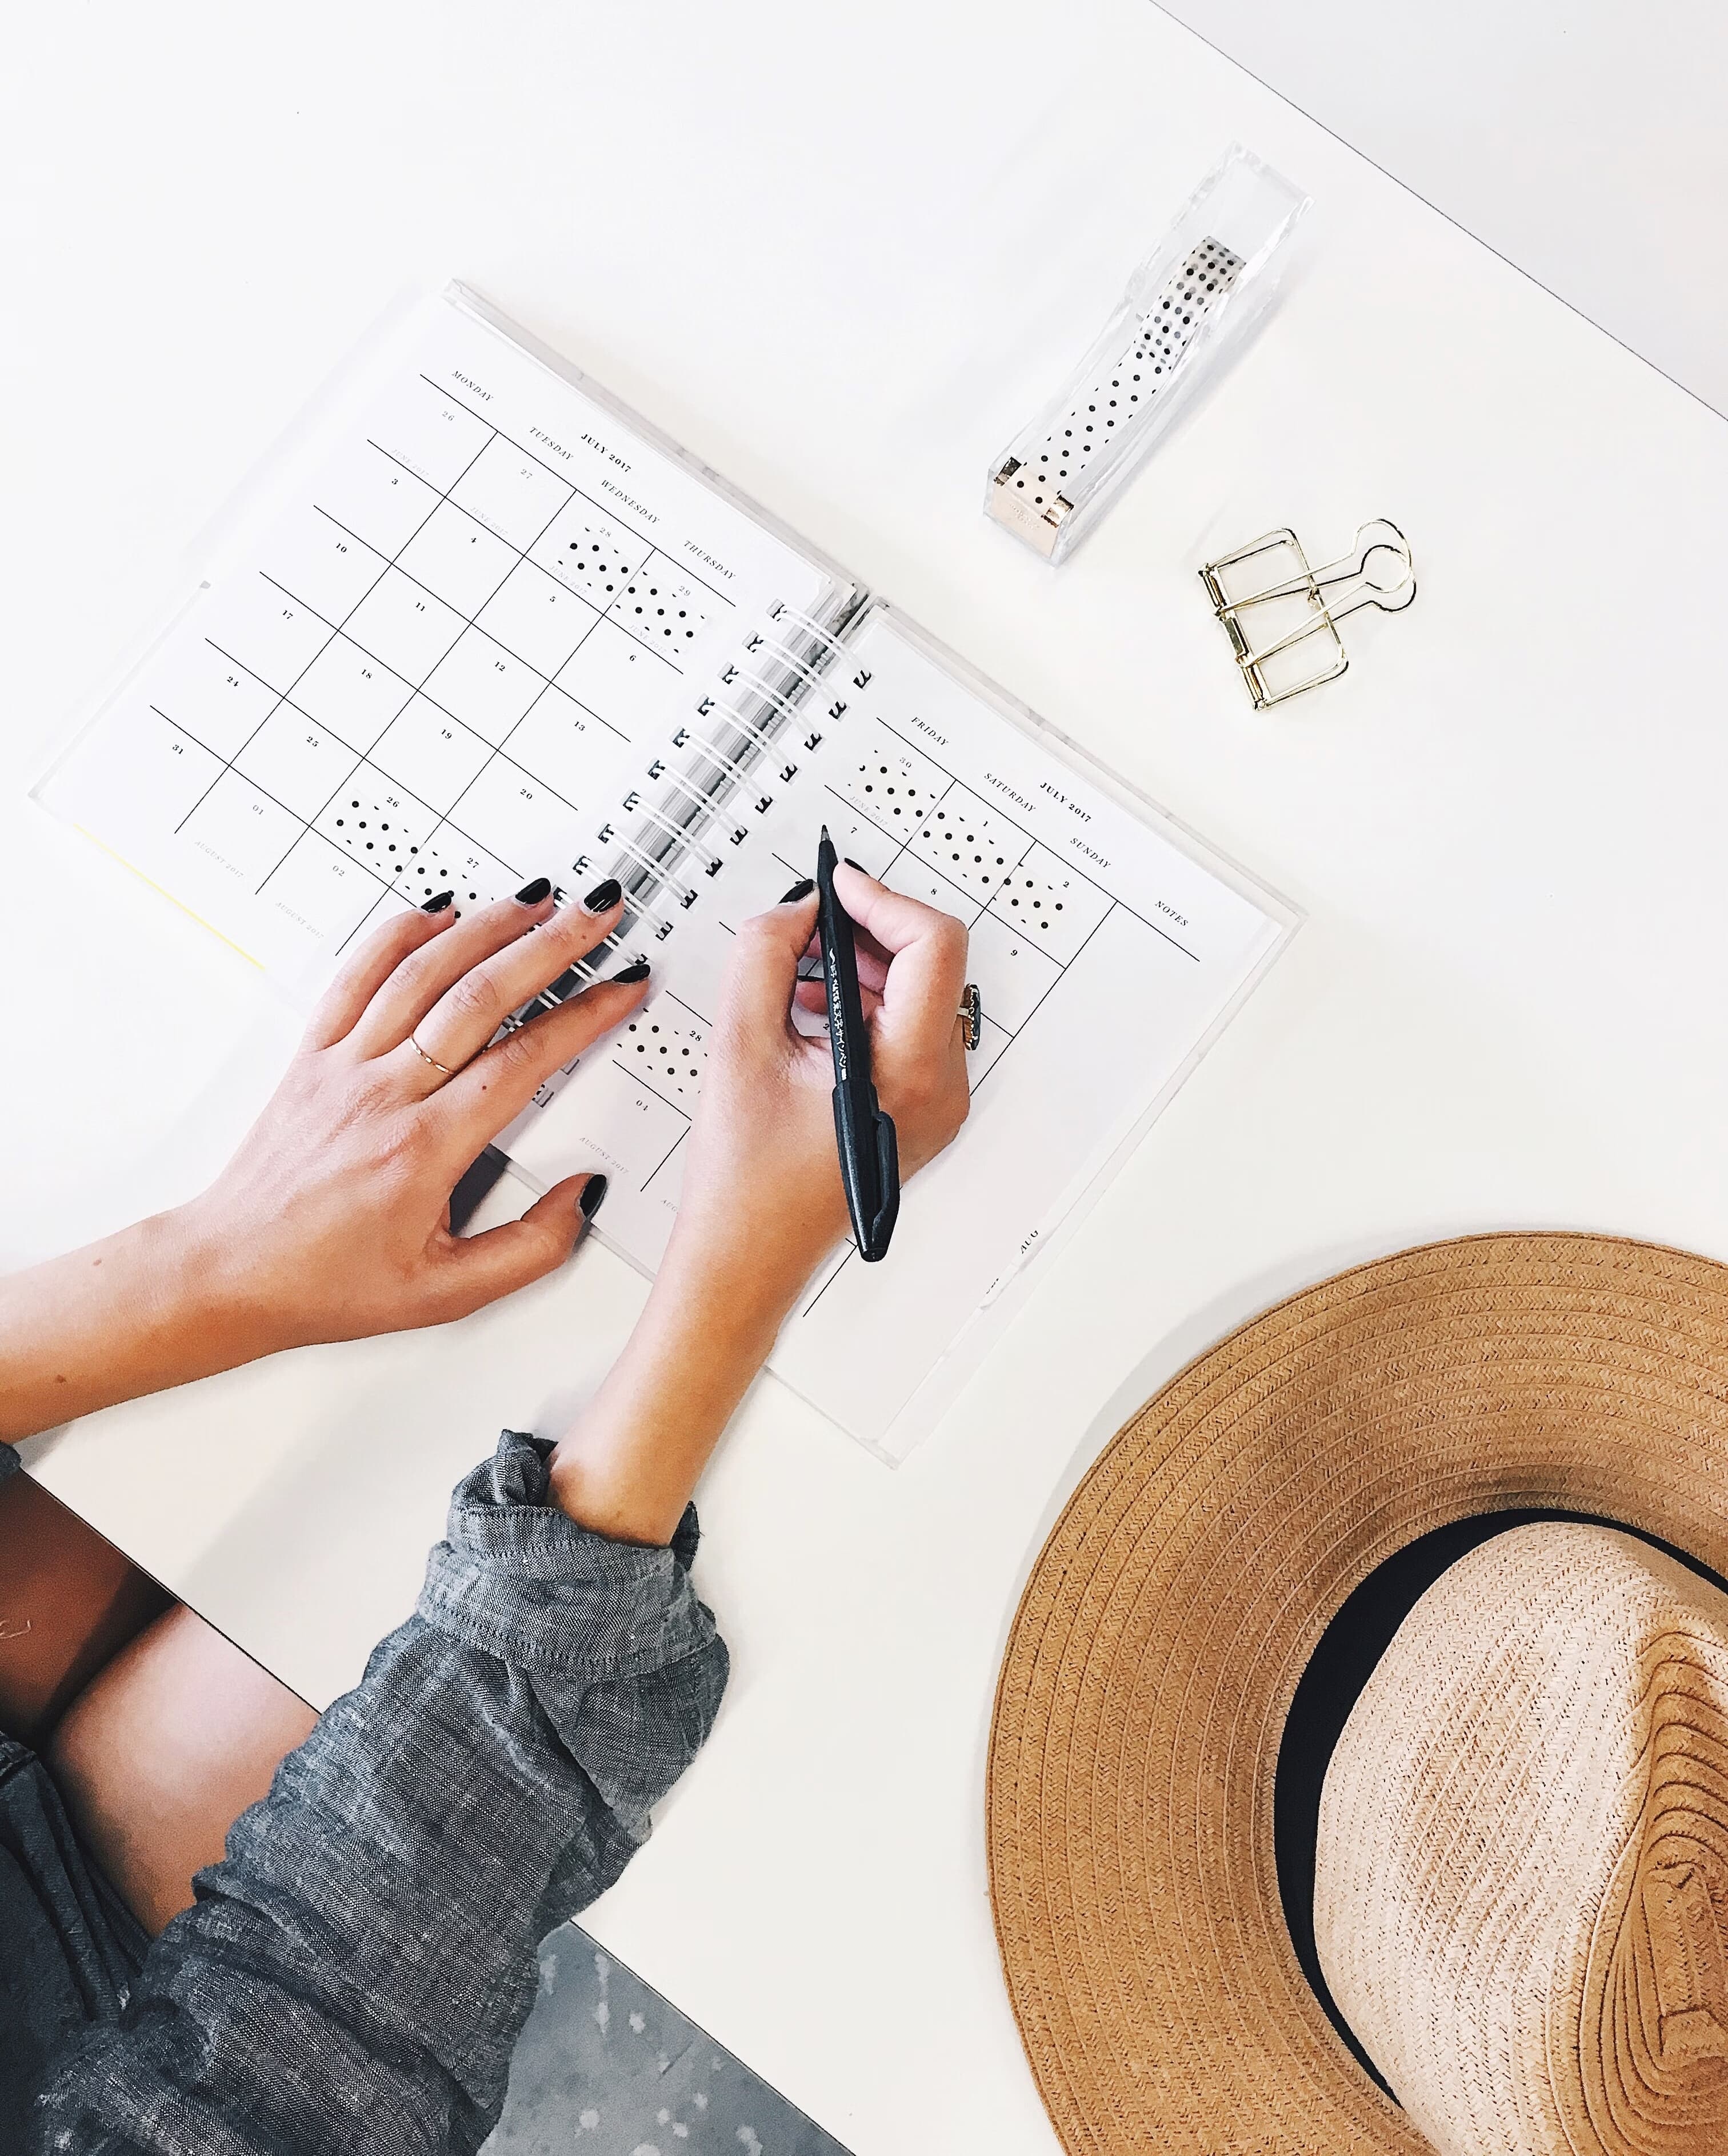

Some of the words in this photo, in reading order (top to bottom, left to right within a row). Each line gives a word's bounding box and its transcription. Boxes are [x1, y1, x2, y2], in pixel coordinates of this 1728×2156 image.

[451, 371, 494, 401] MONDAY
[442, 411, 454, 421] 26
[529, 427, 574, 459] TUESDAY
[581, 434, 608, 454] JULY
[609, 454, 631, 472] 2017
[521, 469, 533, 479] 27
[601, 480, 660, 523] WEDNESDAY
[599, 527, 611, 538] 28
[336, 542, 347, 553] 10
[684, 540, 736, 580] THURSDAY
[678, 585, 690, 596] 29
[548, 595, 557, 603] 5
[415, 602, 425, 611] 11
[282, 610, 293, 619] 17
[494, 661, 505, 671] 12
[361, 669, 375, 680] 18
[226, 677, 239, 688] 24
[574, 721, 585, 731] 13
[911, 717, 949, 745] FRIDAY
[441, 729, 453, 740] 19
[306, 737, 319, 747] 25
[172, 745, 183, 754] 31
[899, 757, 913, 768] 30
[520, 789, 534, 799] 20
[984, 773, 1036, 811] SATURDAY
[386, 797, 399, 807] 26
[1040, 782, 1070, 803] JULY
[1069, 804, 1091, 822] 2017
[253, 805, 265, 815] 01
[982, 820, 989, 828] 1
[850, 826, 858, 834] 7
[1070, 838, 1111, 868] SUNDAY
[194, 841, 226, 864] AUGUST
[226, 864, 245, 878] 2017
[466, 858, 479, 869] 27
[333, 866, 347, 877] 02
[1062, 881, 1070, 889] 2
[930, 887, 938, 895] 8
[275, 902, 306, 925] AUGUST
[306, 923, 324, 938] 2017
[1154, 901, 1189, 928] NOTES
[1010, 948, 1018, 957] 9
[823, 1023, 830, 1031] 2
[689, 1030, 702, 1041] 28
[636, 1100, 648, 1111] 04
[579, 1138, 611, 1159] AUGUST
[611, 1159, 629, 1174] 2017
[661, 1199, 678, 1214] AUG
[1020, 1230, 1039, 1254] AUG
